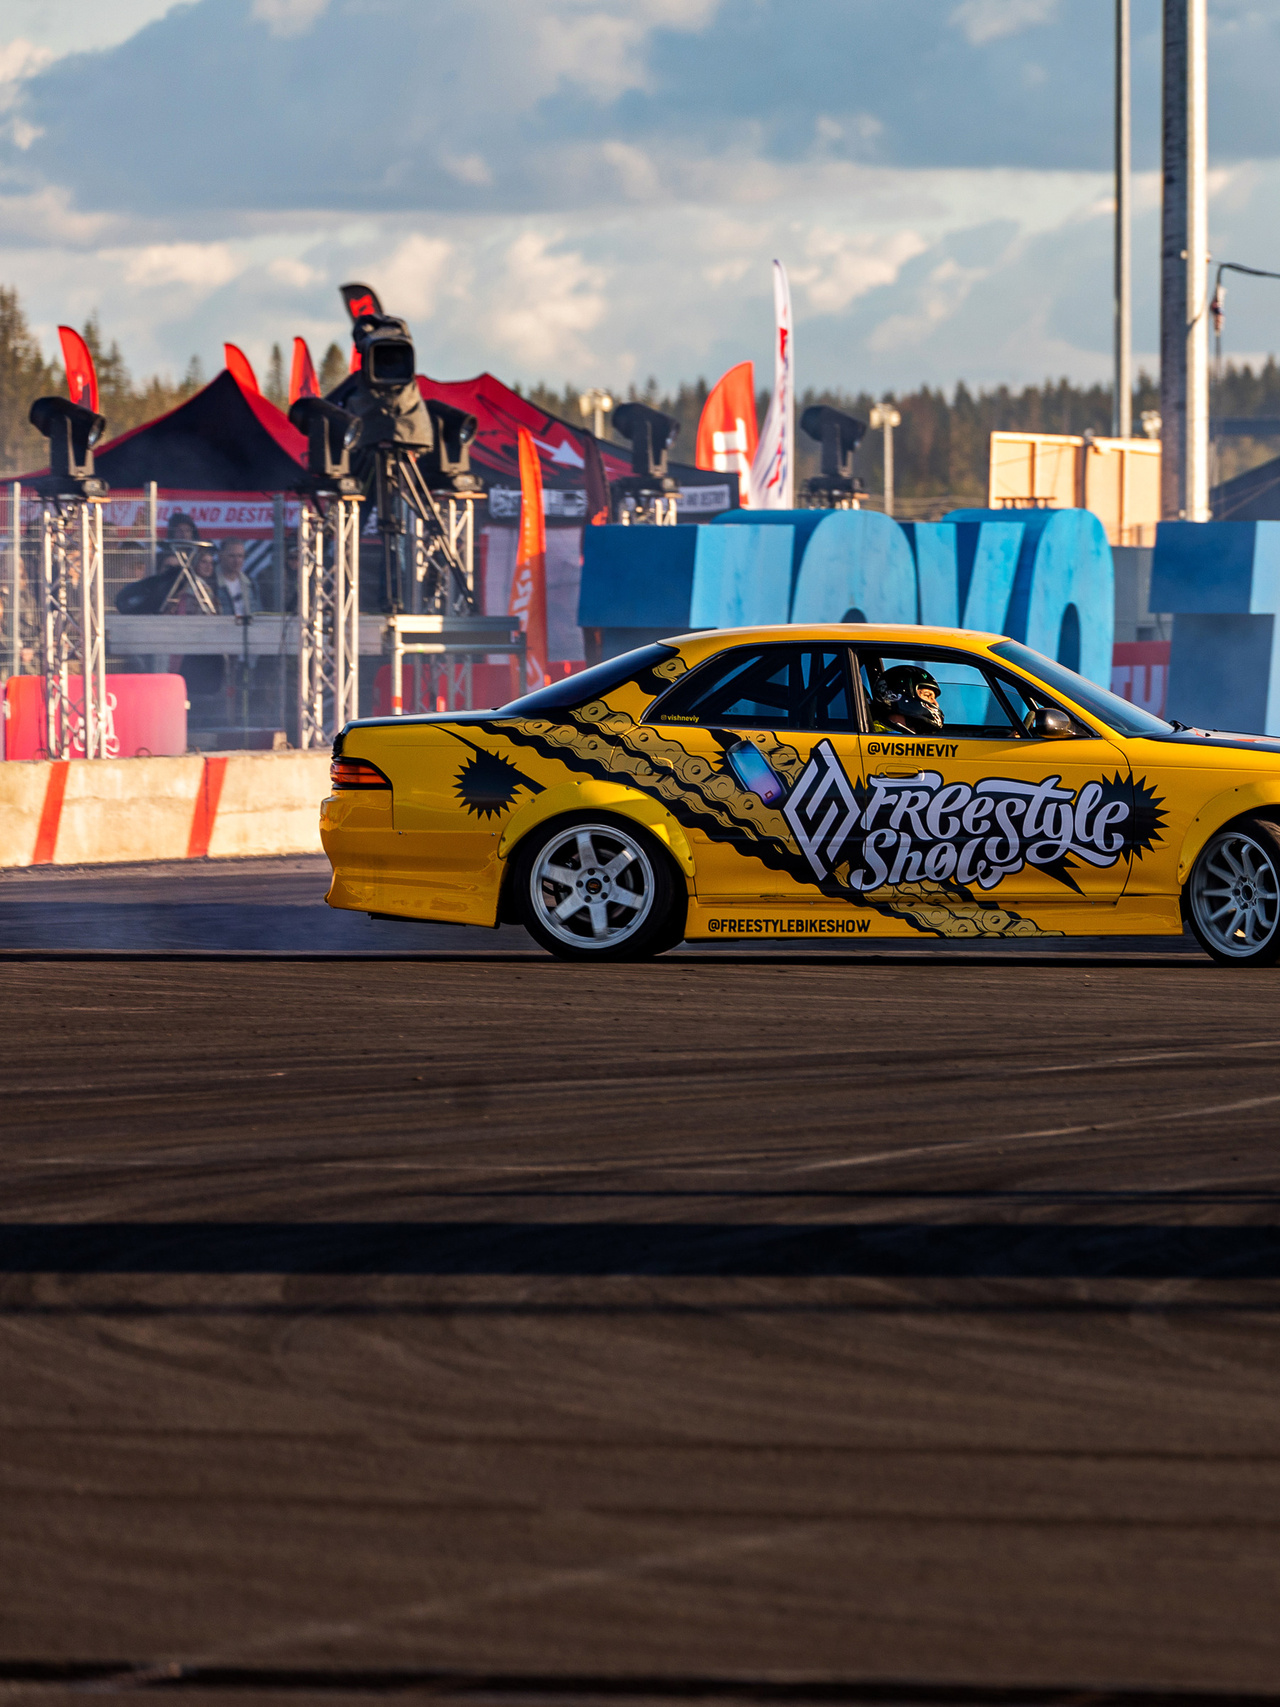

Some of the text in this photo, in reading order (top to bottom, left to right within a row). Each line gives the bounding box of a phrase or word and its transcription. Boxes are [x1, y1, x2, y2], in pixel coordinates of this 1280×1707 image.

[225, 507, 299, 523] DESTRY
[867, 743, 959, 757] @VISHNEVIY
[850, 828, 1023, 892] Show
[707, 918, 871, 934] @FREESTYLEBIKESHOW
